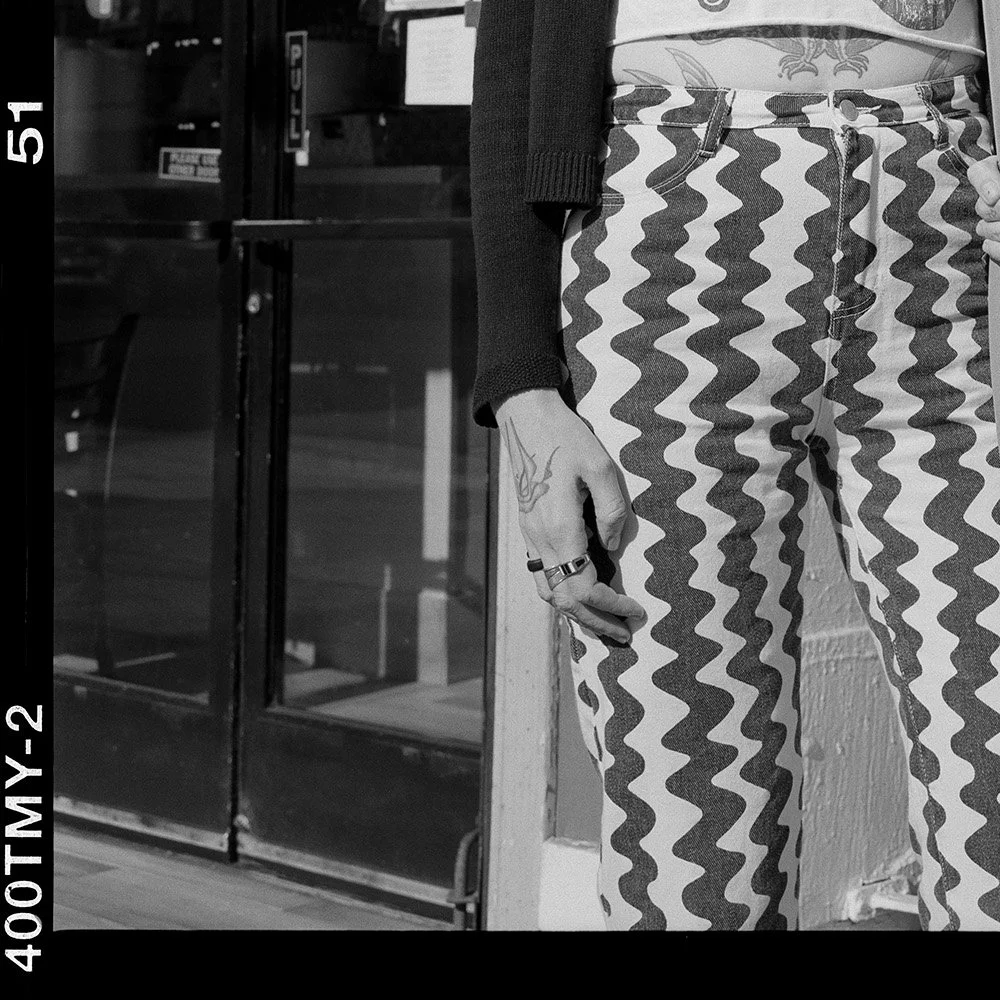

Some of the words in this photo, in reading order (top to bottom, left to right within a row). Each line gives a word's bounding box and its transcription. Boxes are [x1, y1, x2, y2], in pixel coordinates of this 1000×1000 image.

[8, 101, 43, 165] 51
[290, 43, 302, 140] PULL
[4, 704, 43, 973] 400TMY-2
